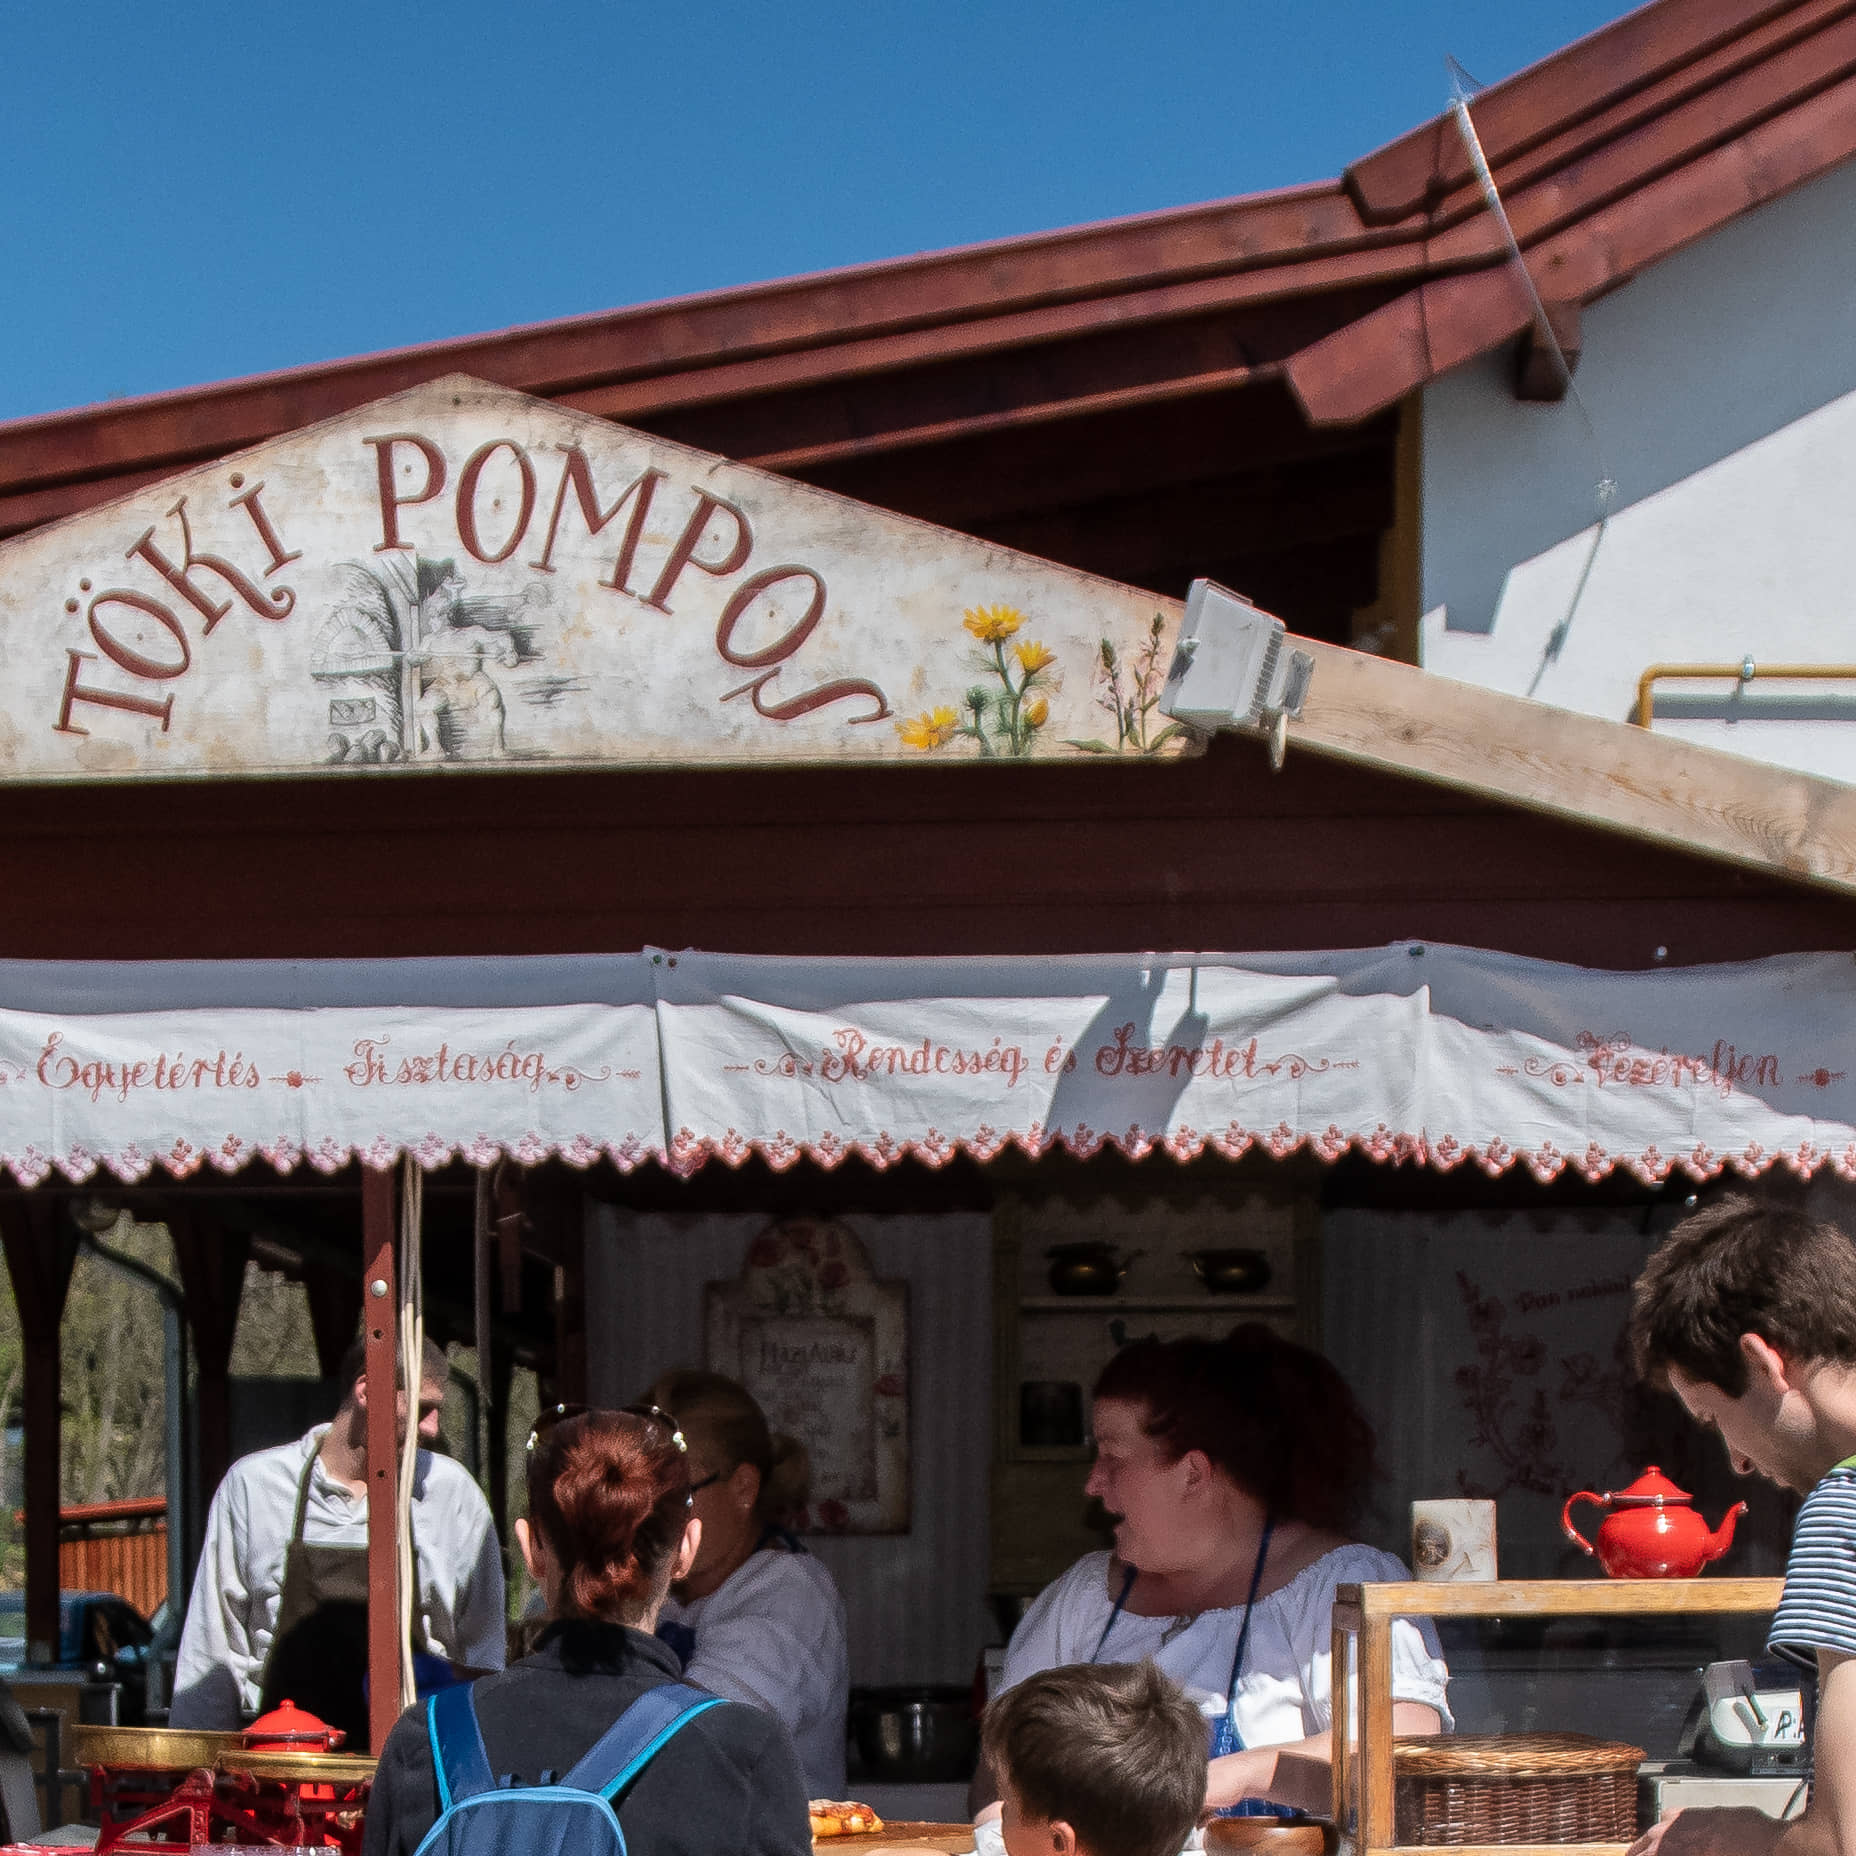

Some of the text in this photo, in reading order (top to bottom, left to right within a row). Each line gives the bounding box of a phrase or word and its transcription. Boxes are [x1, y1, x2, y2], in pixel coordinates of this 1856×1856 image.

[361, 428, 893, 727] POMPOS
[36, 1030, 549, 1103] Egyetértés Tisztaság
[819, 1021, 1265, 1088] Rendesség és Szeretet
